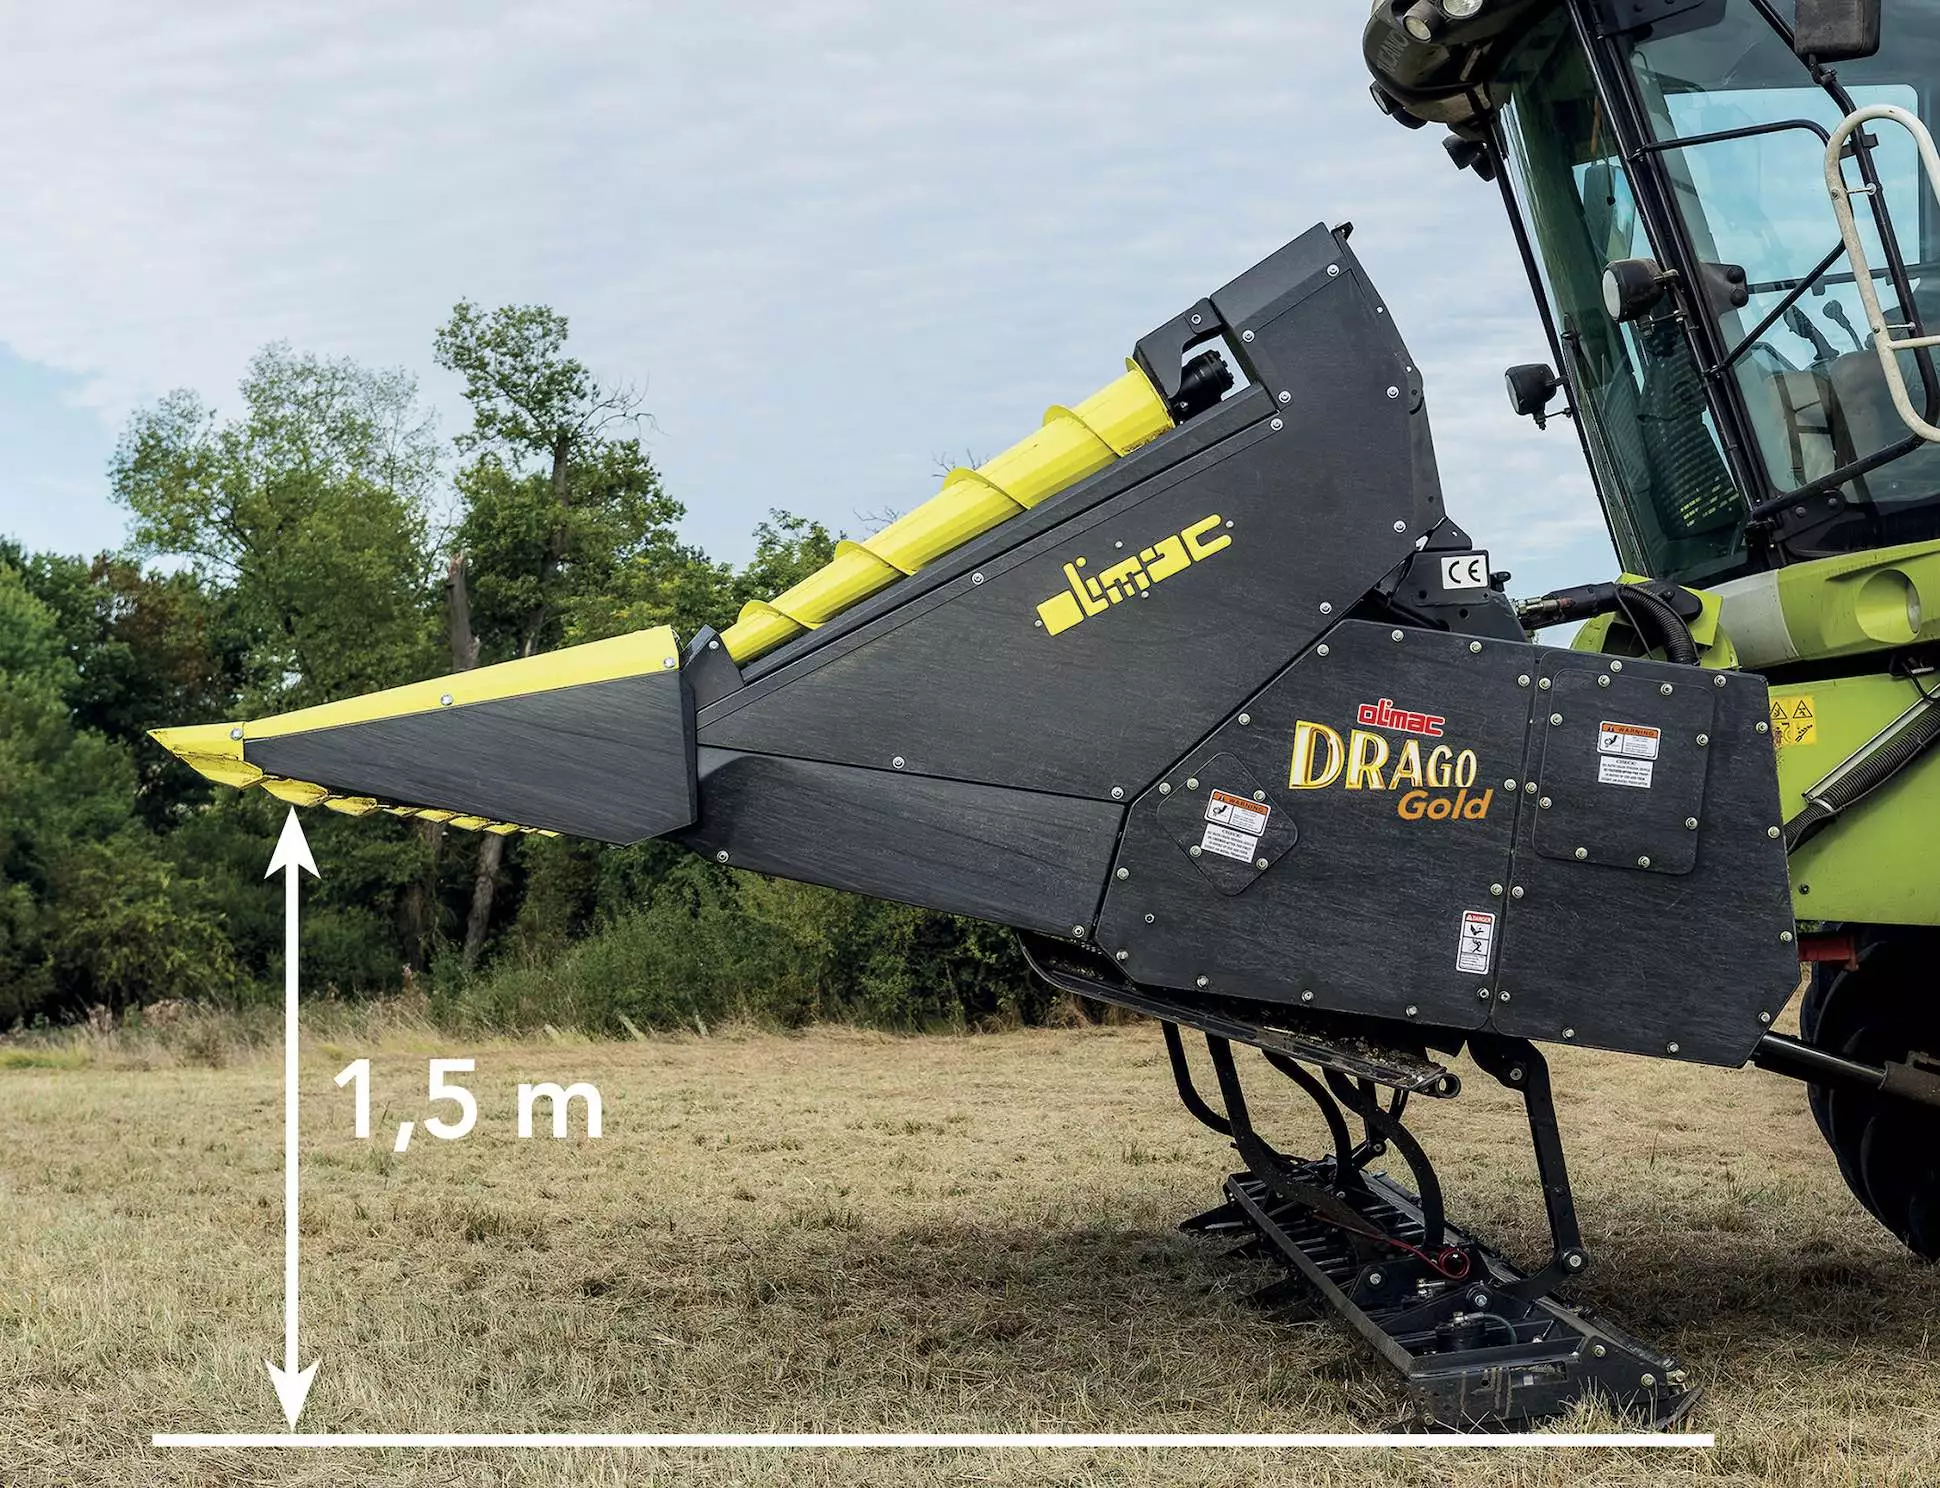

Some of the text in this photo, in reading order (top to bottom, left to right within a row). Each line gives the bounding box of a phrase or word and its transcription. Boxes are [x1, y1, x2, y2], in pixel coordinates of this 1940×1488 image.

[1449, 560, 1480, 584] CE
[1357, 698, 1445, 737] olimac
[1618, 727, 1655, 737] WARNING
[1289, 720, 1477, 790] DRAGO
[1229, 798, 1264, 813] WARNING
[1397, 788, 1494, 820] Gold
